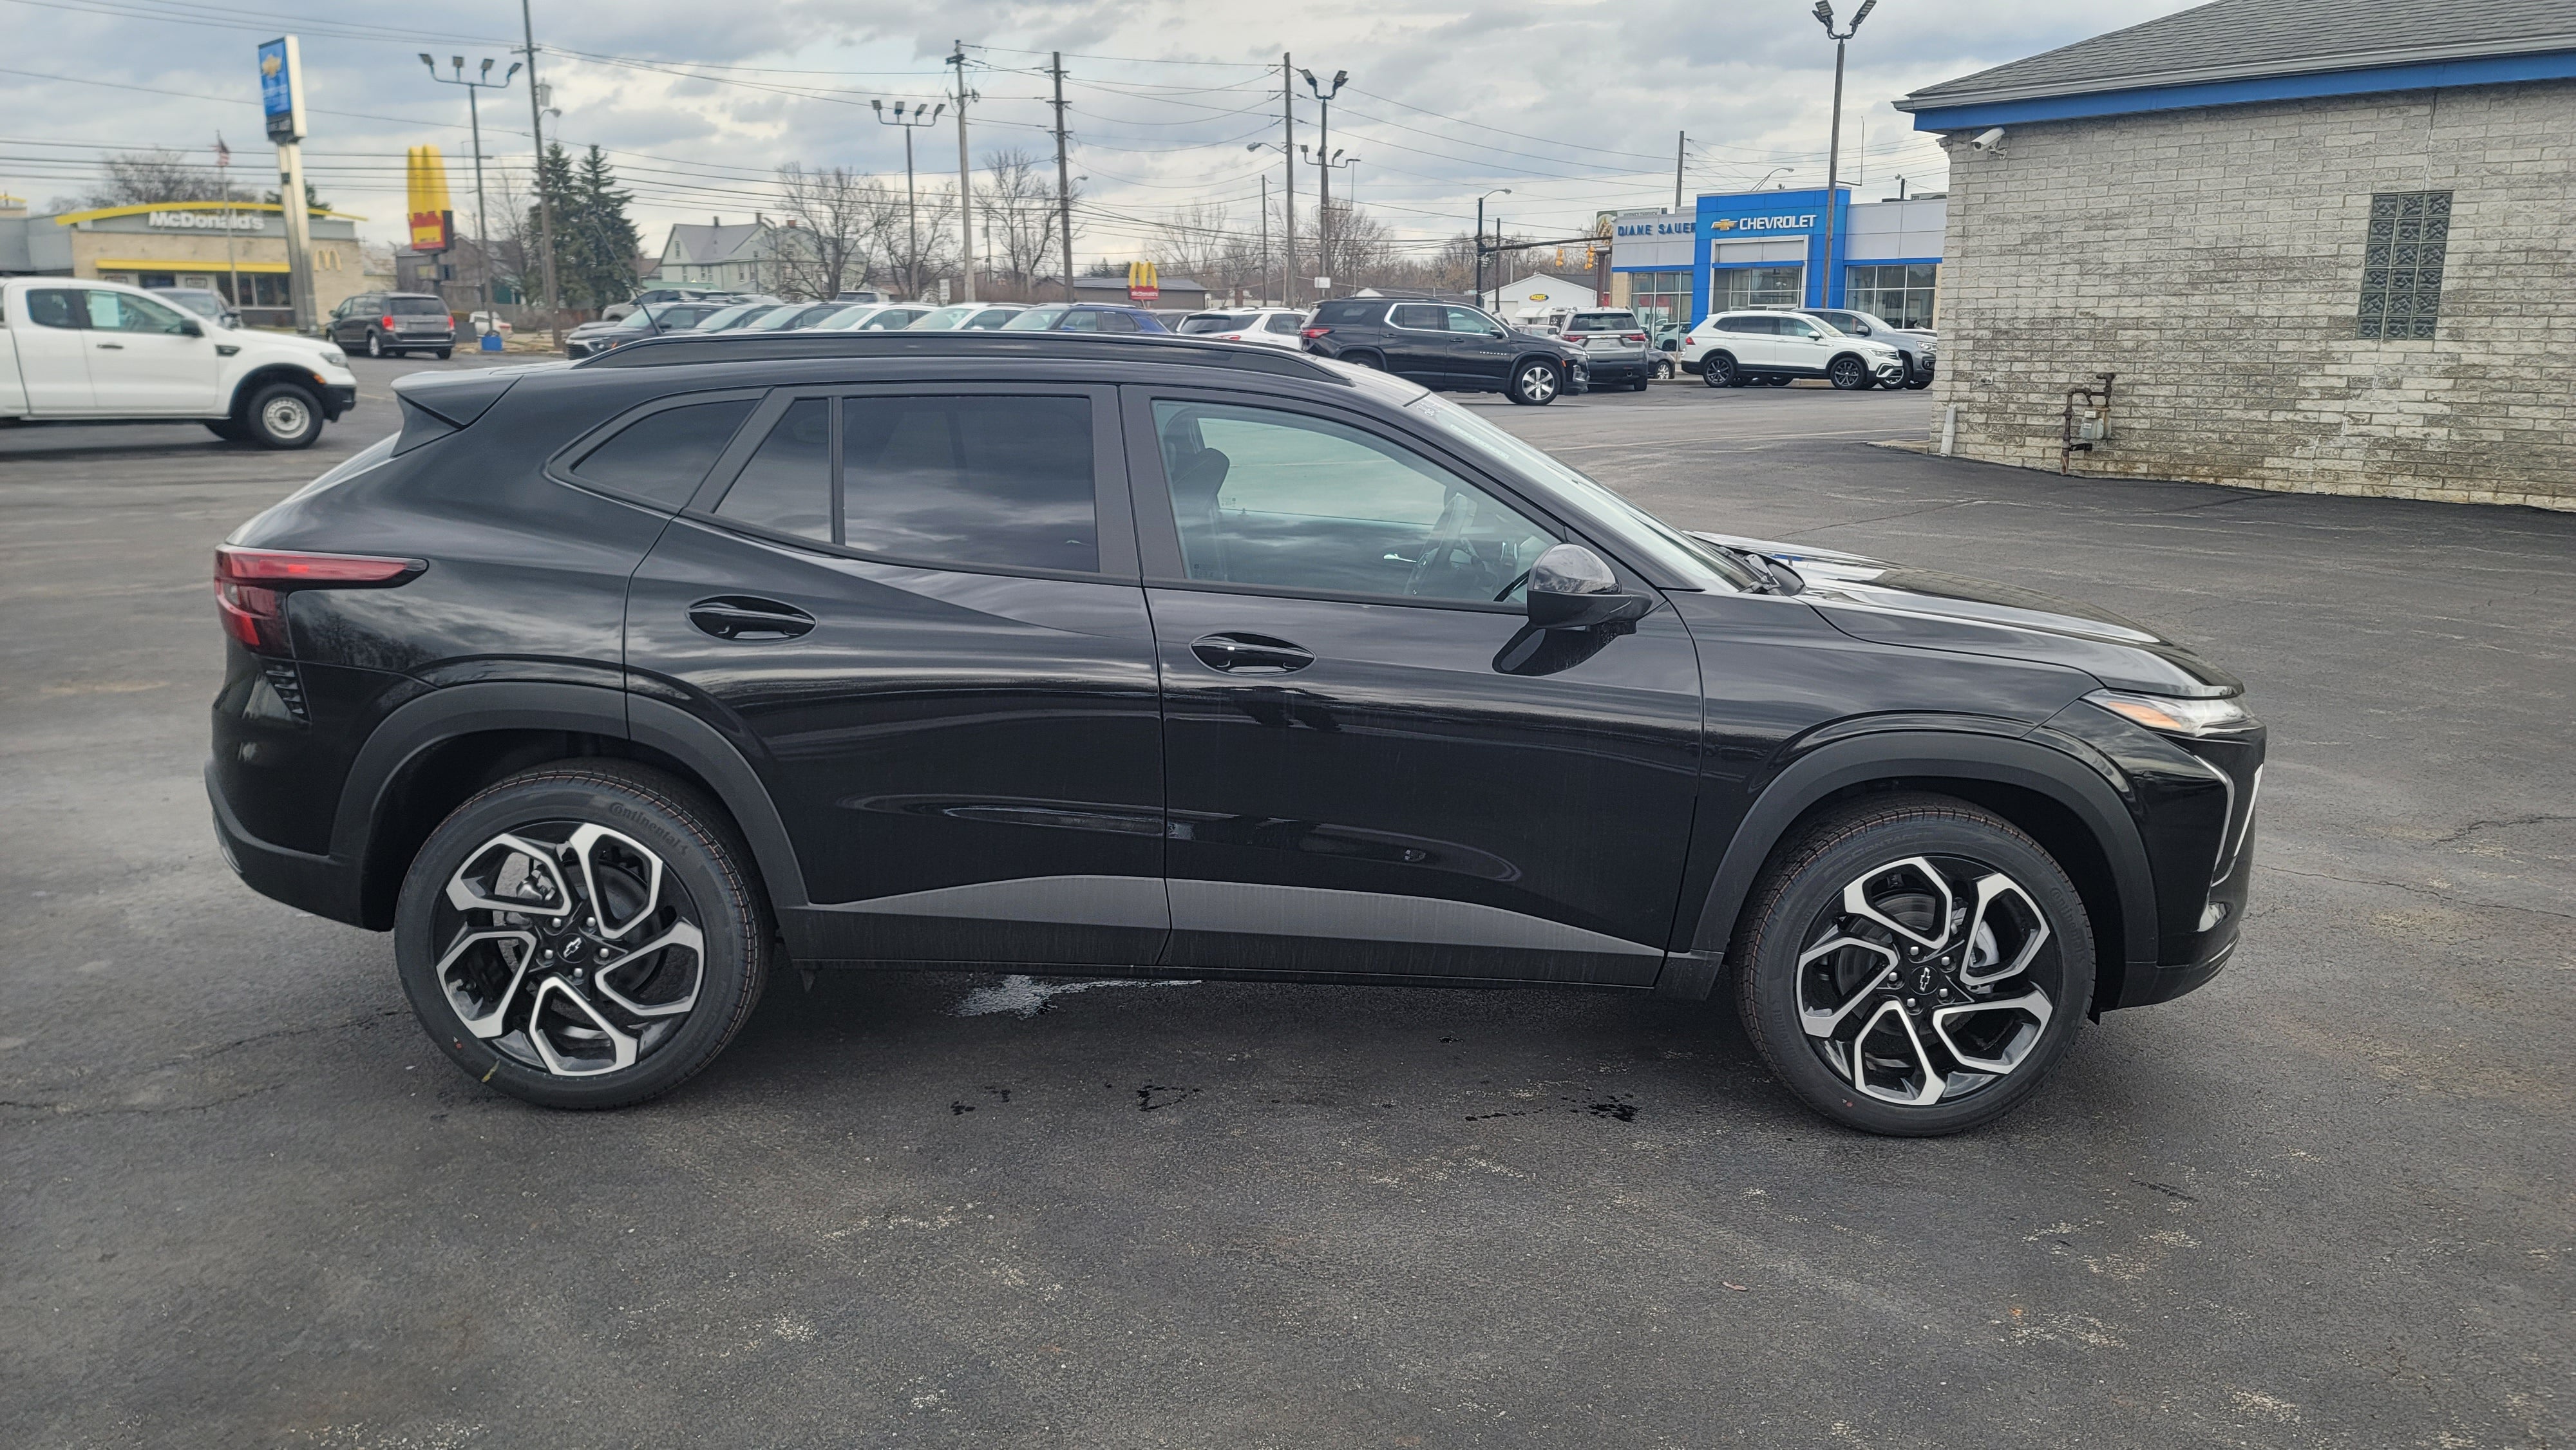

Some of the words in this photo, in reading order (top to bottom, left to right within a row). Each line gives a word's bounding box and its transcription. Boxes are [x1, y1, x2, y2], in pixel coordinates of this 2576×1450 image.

[148, 209, 265, 231] McDonald's
[1739, 214, 1817, 231] CHEVROLET
[1618, 224, 1653, 236] DIANE
[609, 802, 681, 847] Continental
